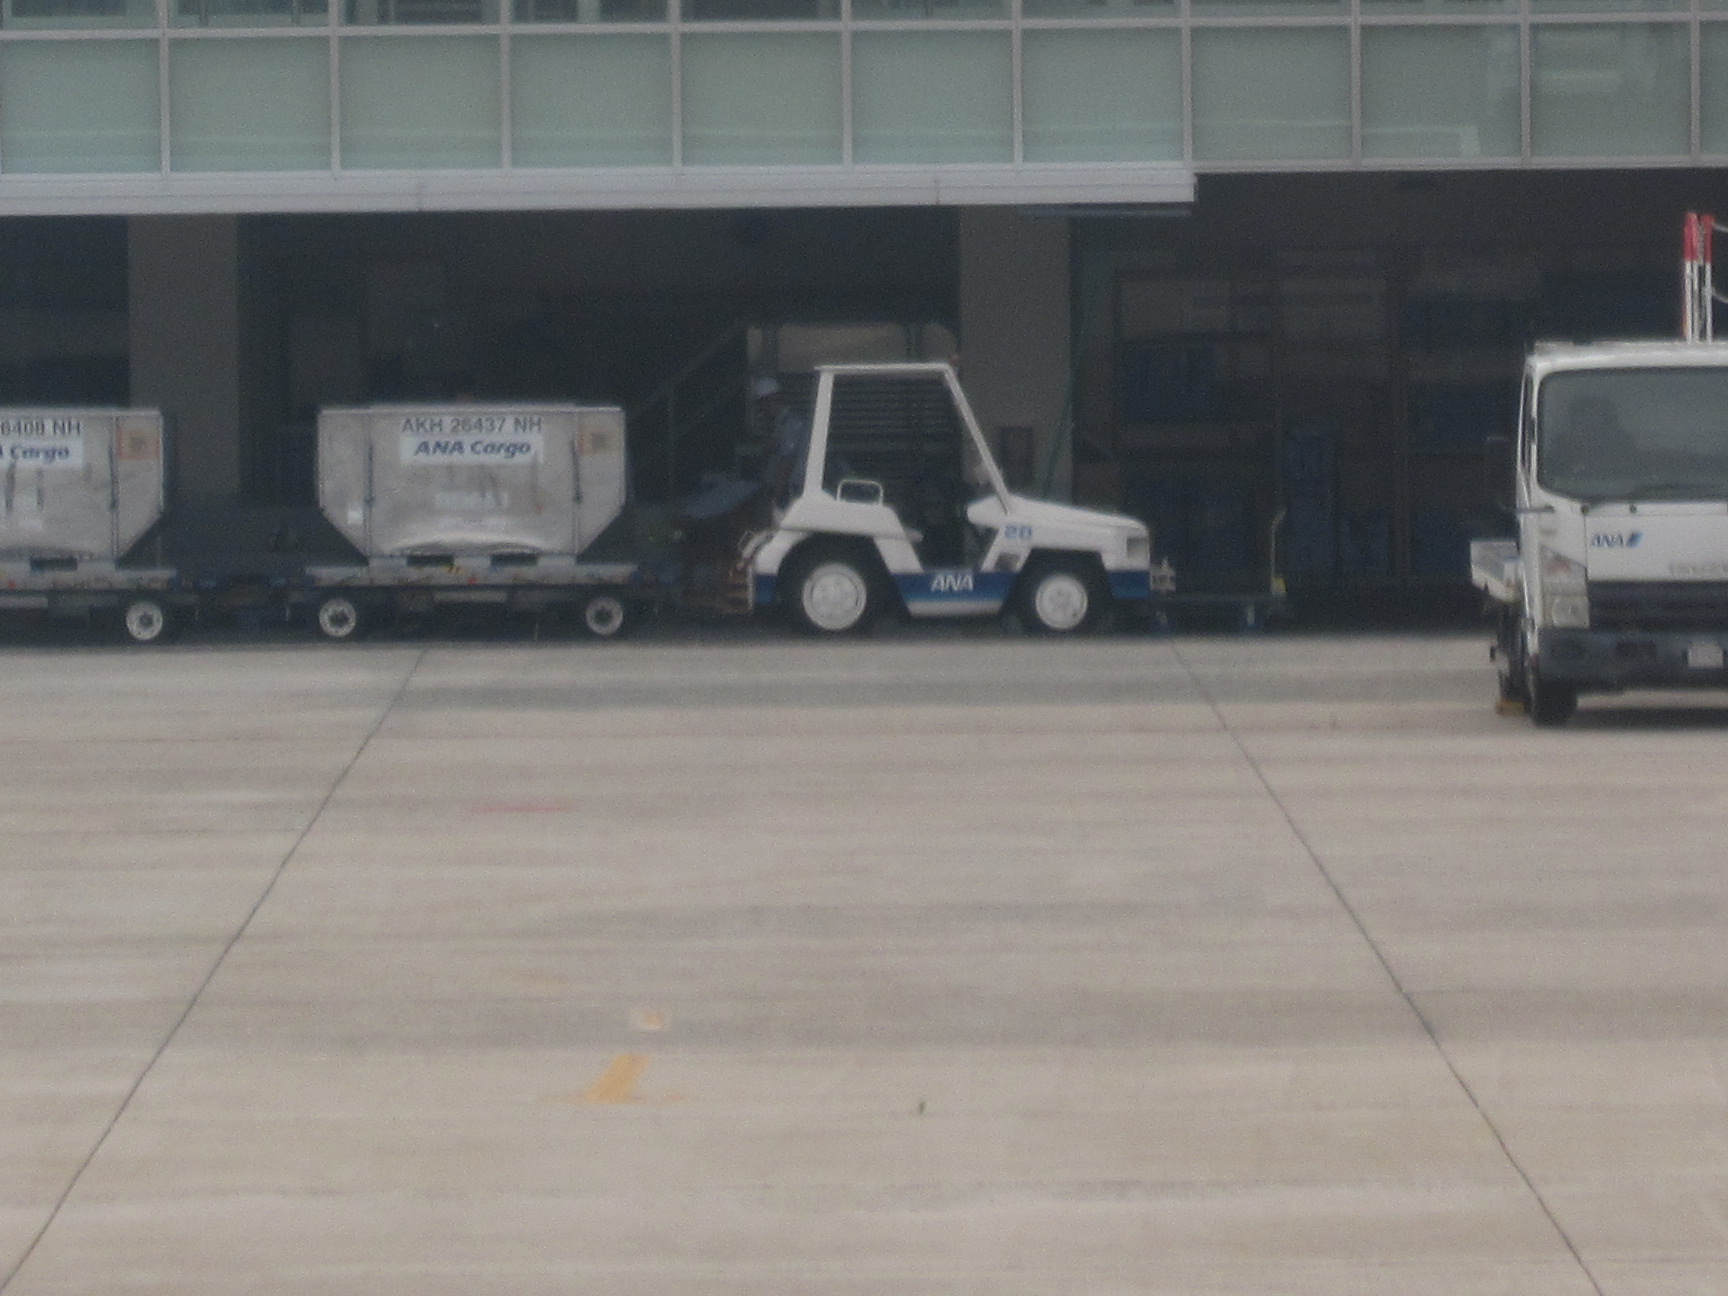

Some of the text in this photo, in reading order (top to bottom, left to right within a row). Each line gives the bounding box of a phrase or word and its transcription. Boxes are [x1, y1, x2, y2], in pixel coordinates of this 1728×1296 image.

[53, 418, 81, 436] NH
[402, 417, 443, 433] AKH
[514, 417, 542, 433] NH
[10, 444, 70, 465] Cargo
[415, 440, 532, 459] ANA Cargo
[1591, 533, 1624, 548] ANA
[930, 572, 974, 592] ANA
